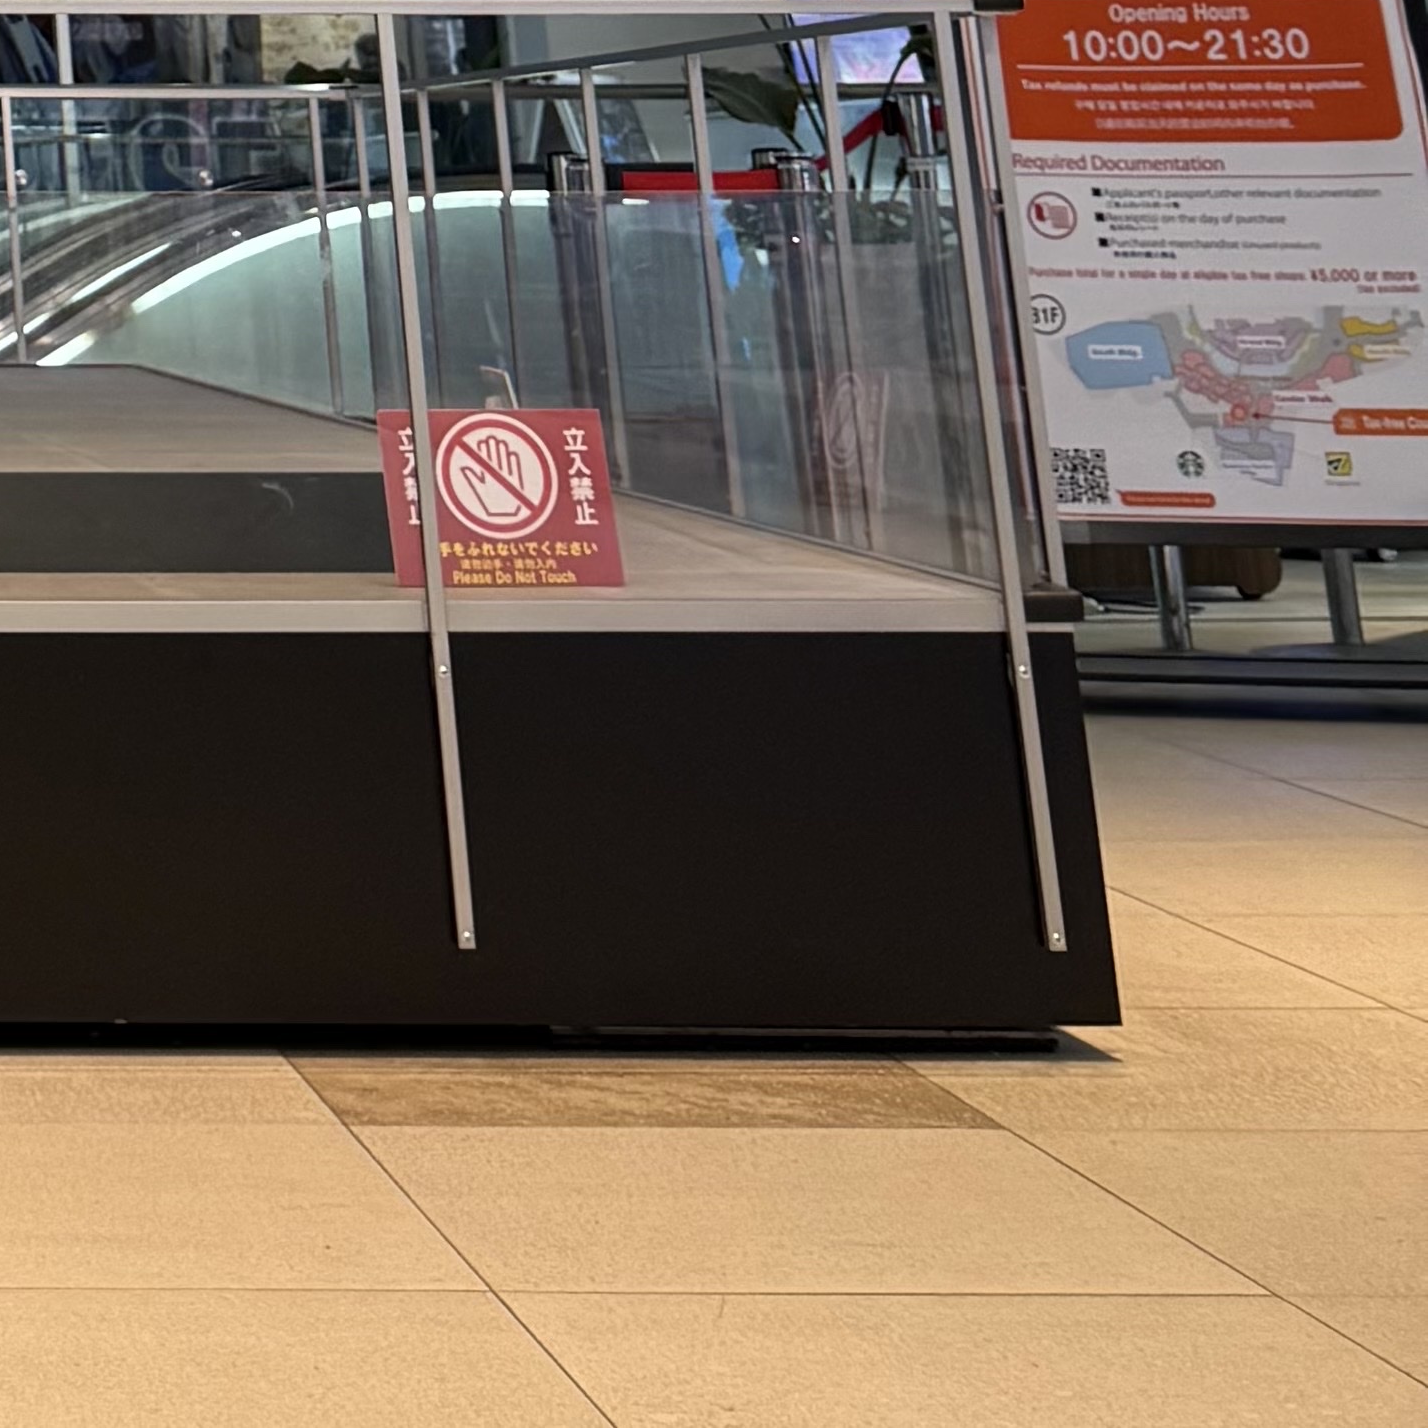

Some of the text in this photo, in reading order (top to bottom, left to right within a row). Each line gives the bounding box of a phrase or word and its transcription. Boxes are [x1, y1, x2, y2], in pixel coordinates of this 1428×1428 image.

[1108, 2, 1250, 24] Opening Hours
[1011, 153, 1226, 173] Required Documentation
[562, 426, 600, 525] 立入禁止
[439, 541, 599, 558] 手をふれないでください
[452, 569, 577, 585] Please Do Not Touch
